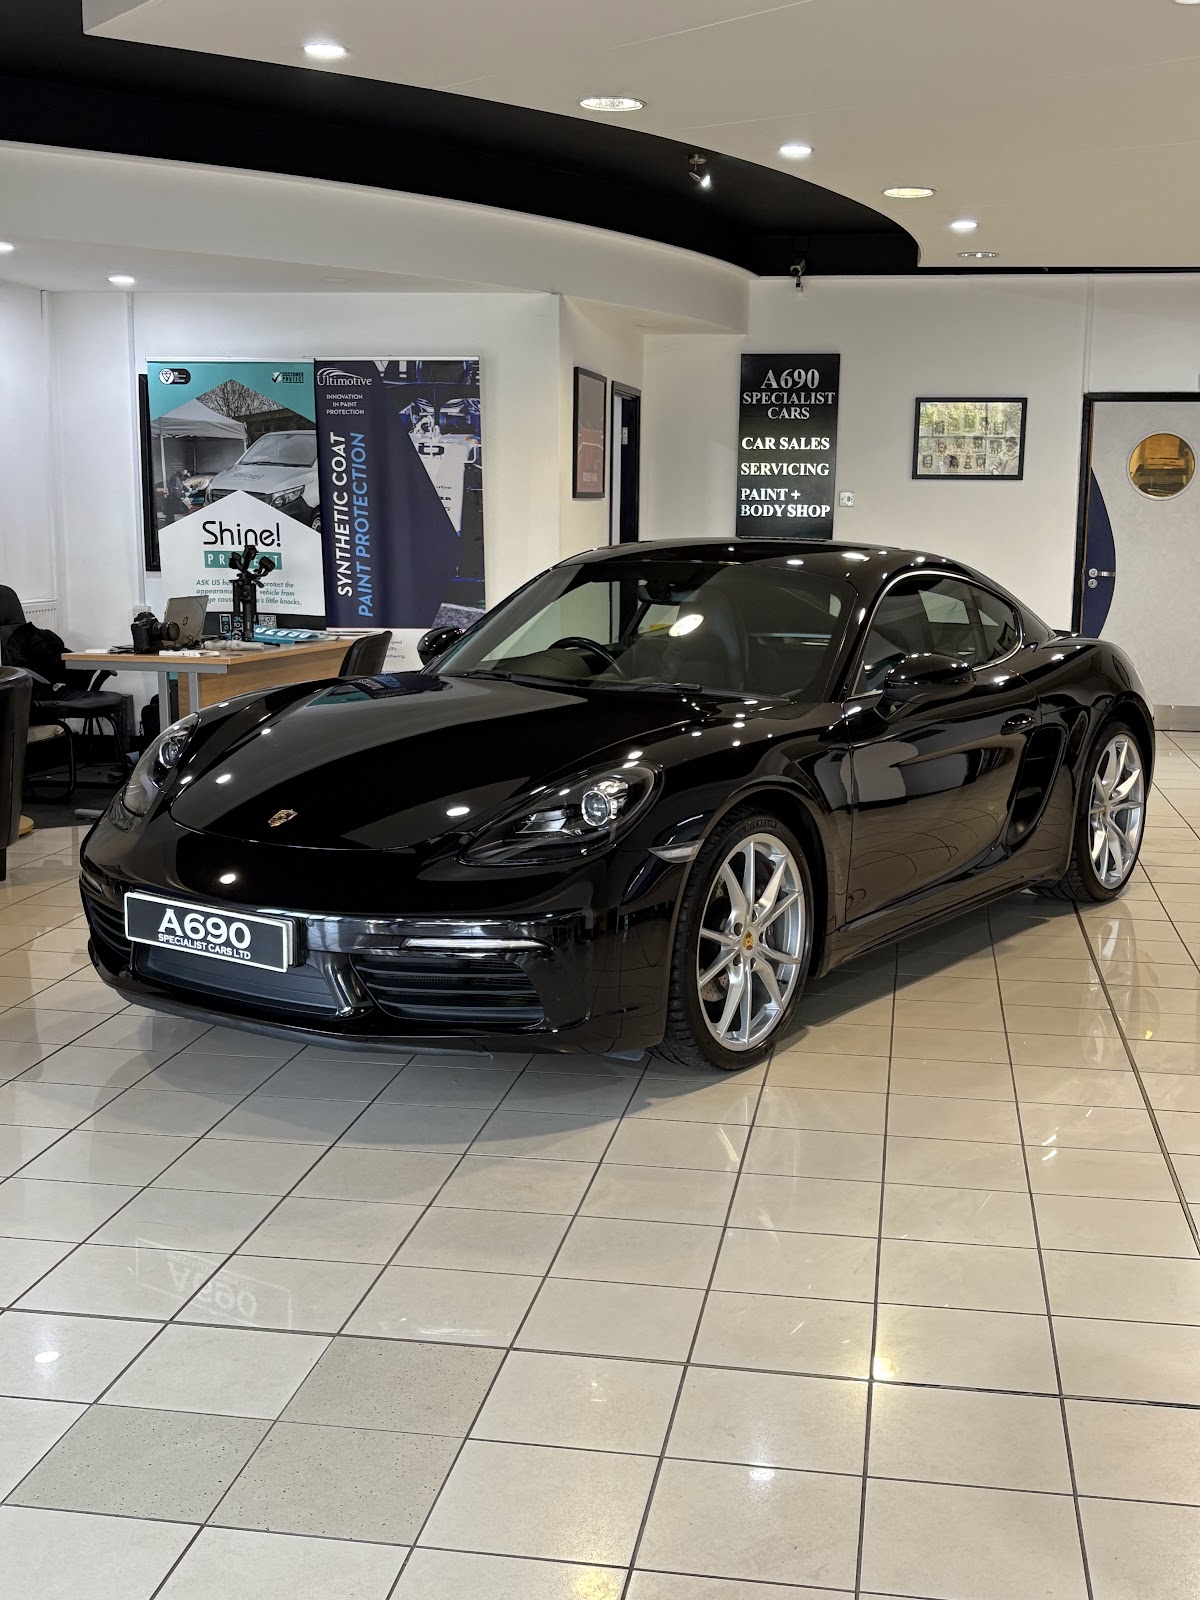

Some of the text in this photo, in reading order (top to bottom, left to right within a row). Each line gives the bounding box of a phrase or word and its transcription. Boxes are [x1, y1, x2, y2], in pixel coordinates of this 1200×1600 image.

[316, 374, 373, 387] Ultimotive
[760, 368, 820, 389] A690
[742, 391, 836, 405] SPECIALIST
[767, 406, 810, 420] CARS
[741, 436, 830, 450] CAR SALES
[740, 462, 829, 476] SERVICING
[740, 487, 801, 501] PAINT +
[331, 432, 353, 597] SYNTHETIC COAT
[740, 504, 831, 518] BODY SHOP
[350, 432, 374, 618] PAINT PROTECTION
[202, 520, 282, 547] Shine!
[281, 589, 295, 597] from
[280, 598, 302, 606] knocks.
[157, 908, 251, 949] A690
[158, 933, 252, 960] SPECIALIST CARS LTD
